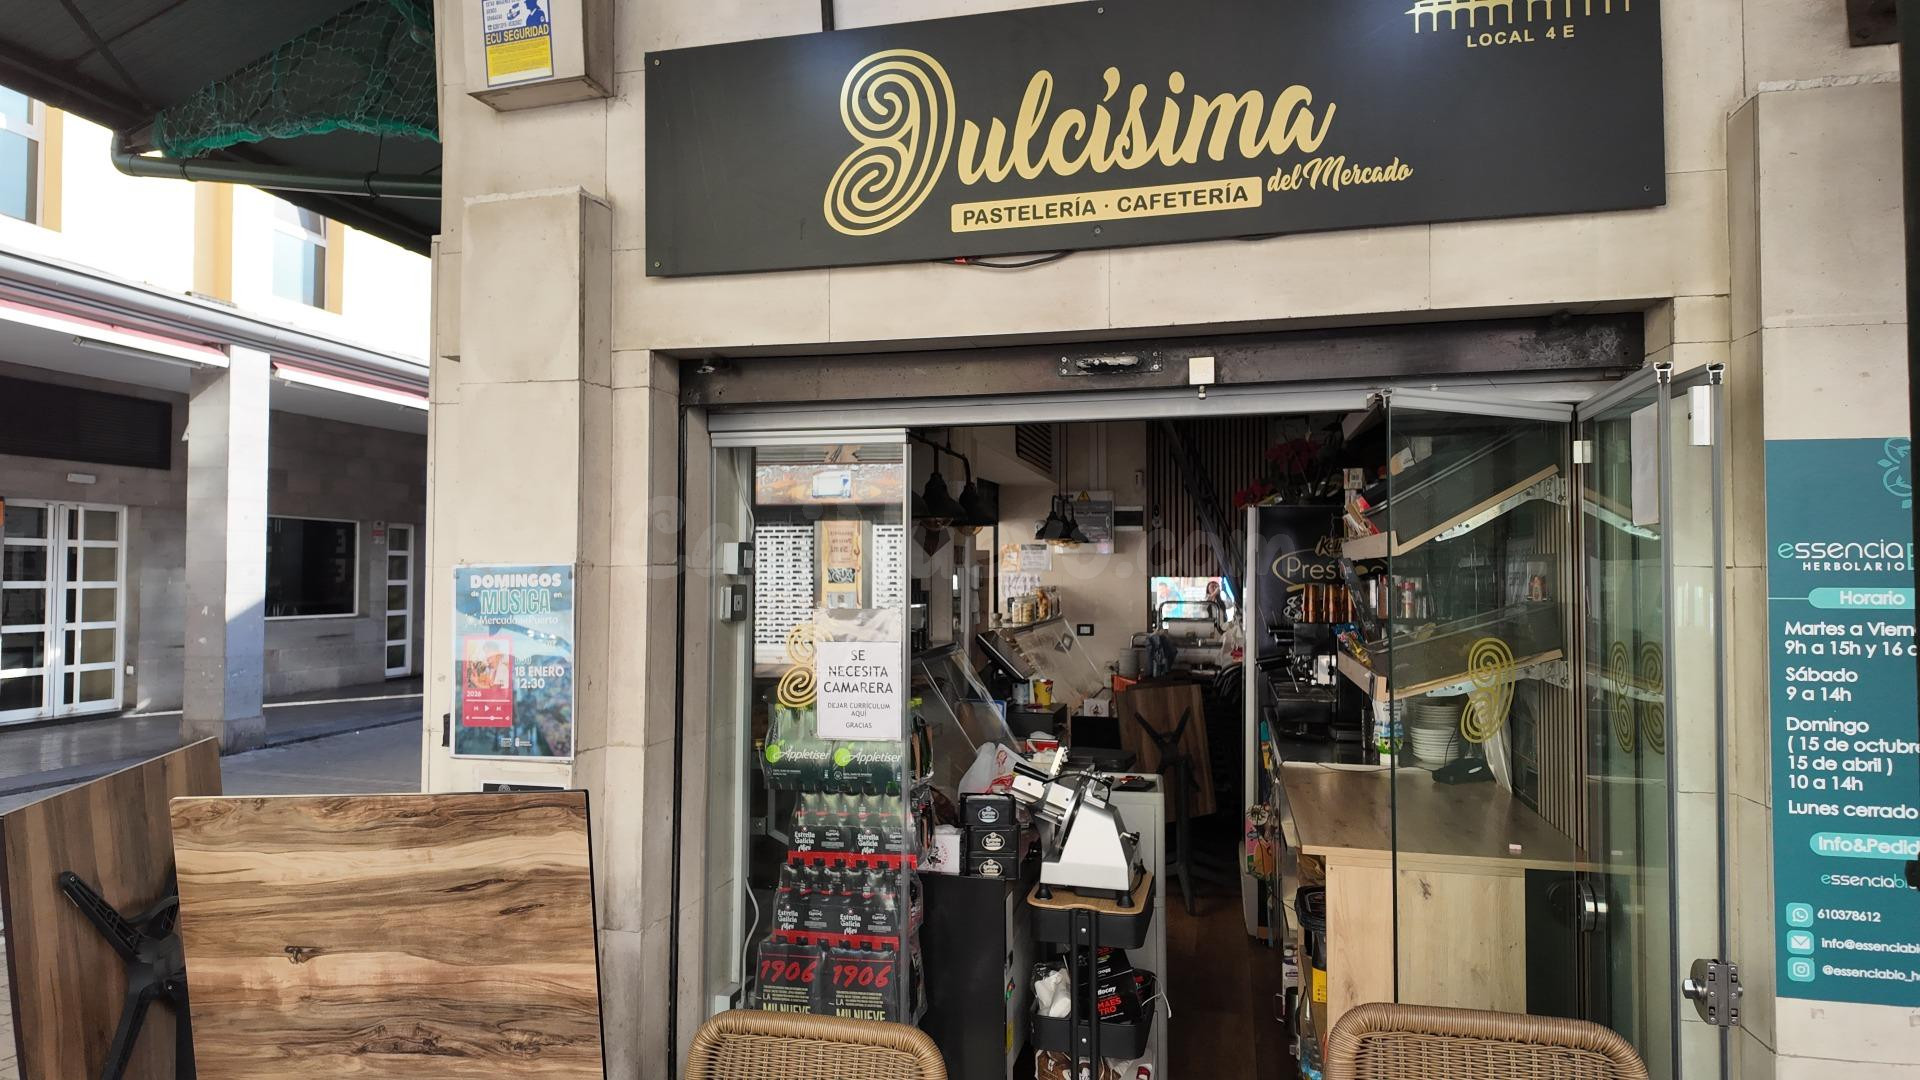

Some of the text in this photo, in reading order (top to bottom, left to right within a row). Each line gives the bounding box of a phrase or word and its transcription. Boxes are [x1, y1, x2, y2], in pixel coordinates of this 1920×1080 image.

[485, 32, 502, 44] ECU
[503, 23, 550, 42] SEGURIDAD
[1466, 24, 1575, 49] LOCAL 4 E
[1267, 158, 1414, 193] del Mercado
[962, 184, 1251, 226] PASTELERÍA CAFETERÍA
[1802, 561, 1905, 572] HERBOLARIO
[470, 573, 562, 589] DOMINGOS
[480, 588, 551, 615] MÚSICA
[1839, 590, 1906, 606] Horario
[479, 615, 517, 625] Mercado
[1784, 621, 1917, 637] Martes a Viern
[851, 650, 865, 662] SE
[1784, 640, 1807, 655] 9h
[1811, 642, 1824, 655] a
[1830, 640, 1861, 656] 15h
[1865, 644, 1877, 659] y
[1883, 641, 1903, 656] 16
[515, 666, 565, 678] 18 ENERO
[828, 666, 889, 678] NECESITA
[1786, 666, 1858, 683] Sábado
[514, 679, 545, 689] 12:30
[823, 682, 893, 694] CAMARERA
[1786, 686, 1851, 702] 9 a 14h
[849, 700, 891, 710] CURRÍCULUM
[851, 709, 867, 718] AQUÍ
[1786, 716, 1870, 735] Domingo
[1800, 736, 1819, 751] 15
[1823, 737, 1849, 752] de
[774, 745, 830, 762] Appletiser
[842, 747, 903, 764] Appletiser
[1788, 755, 1809, 771] 15
[1812, 756, 1837, 771] de
[1842, 757, 1882, 773] abril
[1788, 774, 1863, 791] 10 a 14h
[1788, 799, 1919, 820] Lunes cerrado
[1820, 873, 1917, 890] essenciabi
[777, 909, 798, 917] Estrella
[839, 913, 861, 922] Estrella
[1817, 909, 1881, 923] 610378612
[839, 920, 861, 928] Galicia
[1821, 937, 1920, 955] info@essenciabi
[760, 959, 817, 983] 1906
[832, 965, 892, 988] 1906
[1822, 965, 1920, 982] @essenciabio_h
[836, 998, 844, 1006] LA
[1097, 997, 1121, 1009] MAES
